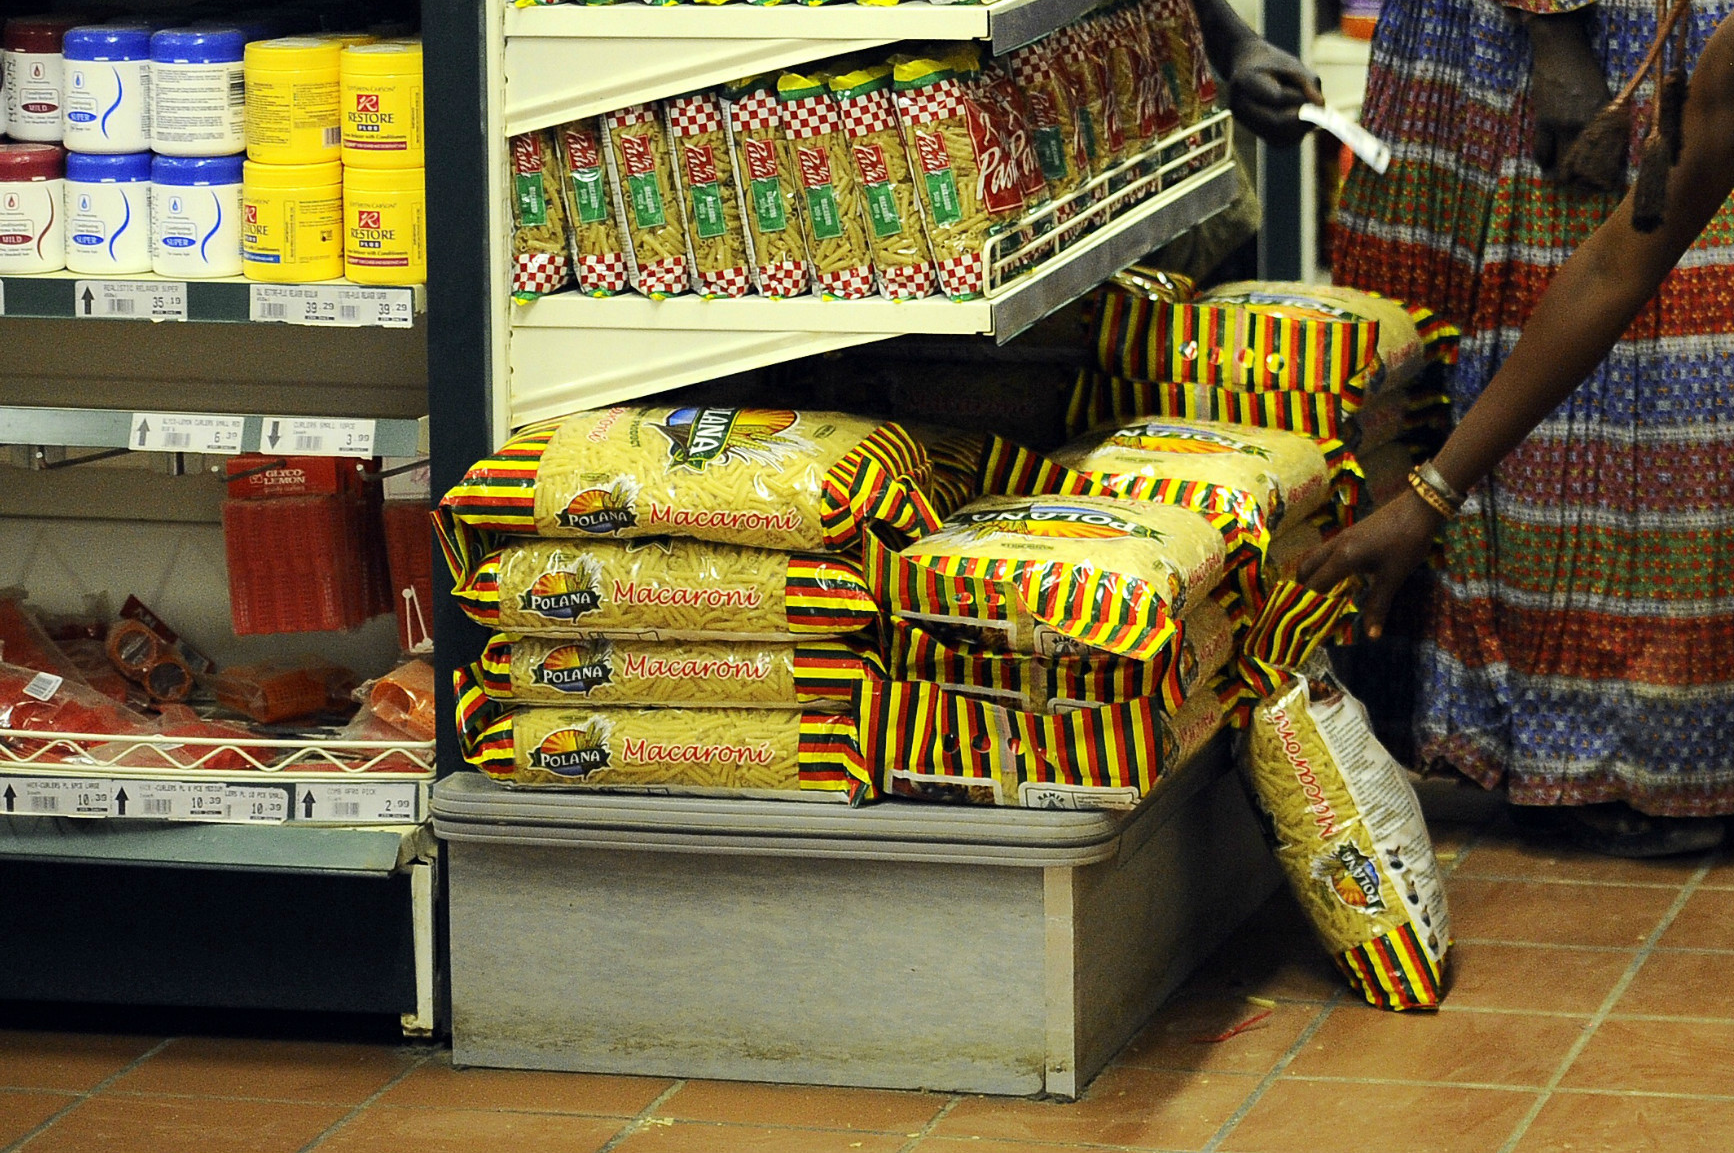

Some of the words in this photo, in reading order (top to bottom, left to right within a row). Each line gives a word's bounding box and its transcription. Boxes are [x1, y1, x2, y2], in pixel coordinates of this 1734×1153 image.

[28, 104, 48, 112] MILD
[348, 113, 394, 124] RESTORE
[2, 236, 22, 244] MILD
[75, 236, 98, 244] SUPER
[166, 238, 189, 246] SUPER
[350, 229, 395, 240] RESTORE
[690, 408, 736, 455] LANA
[263, 476, 306, 485] LEMON
[568, 511, 628, 527] POLANA
[650, 503, 801, 531] Macaroni
[972, 511, 1138, 533] POLANA
[531, 592, 591, 610] POLANA
[613, 580, 761, 607] Macaroni
[543, 665, 603, 684] POLANA
[624, 653, 772, 680] Macaroni
[540, 749, 601, 768] POLANA
[623, 738, 774, 764] Macaroni
[1266, 708, 1339, 839] Macaroni
[1340, 850, 1378, 906] POLANA
